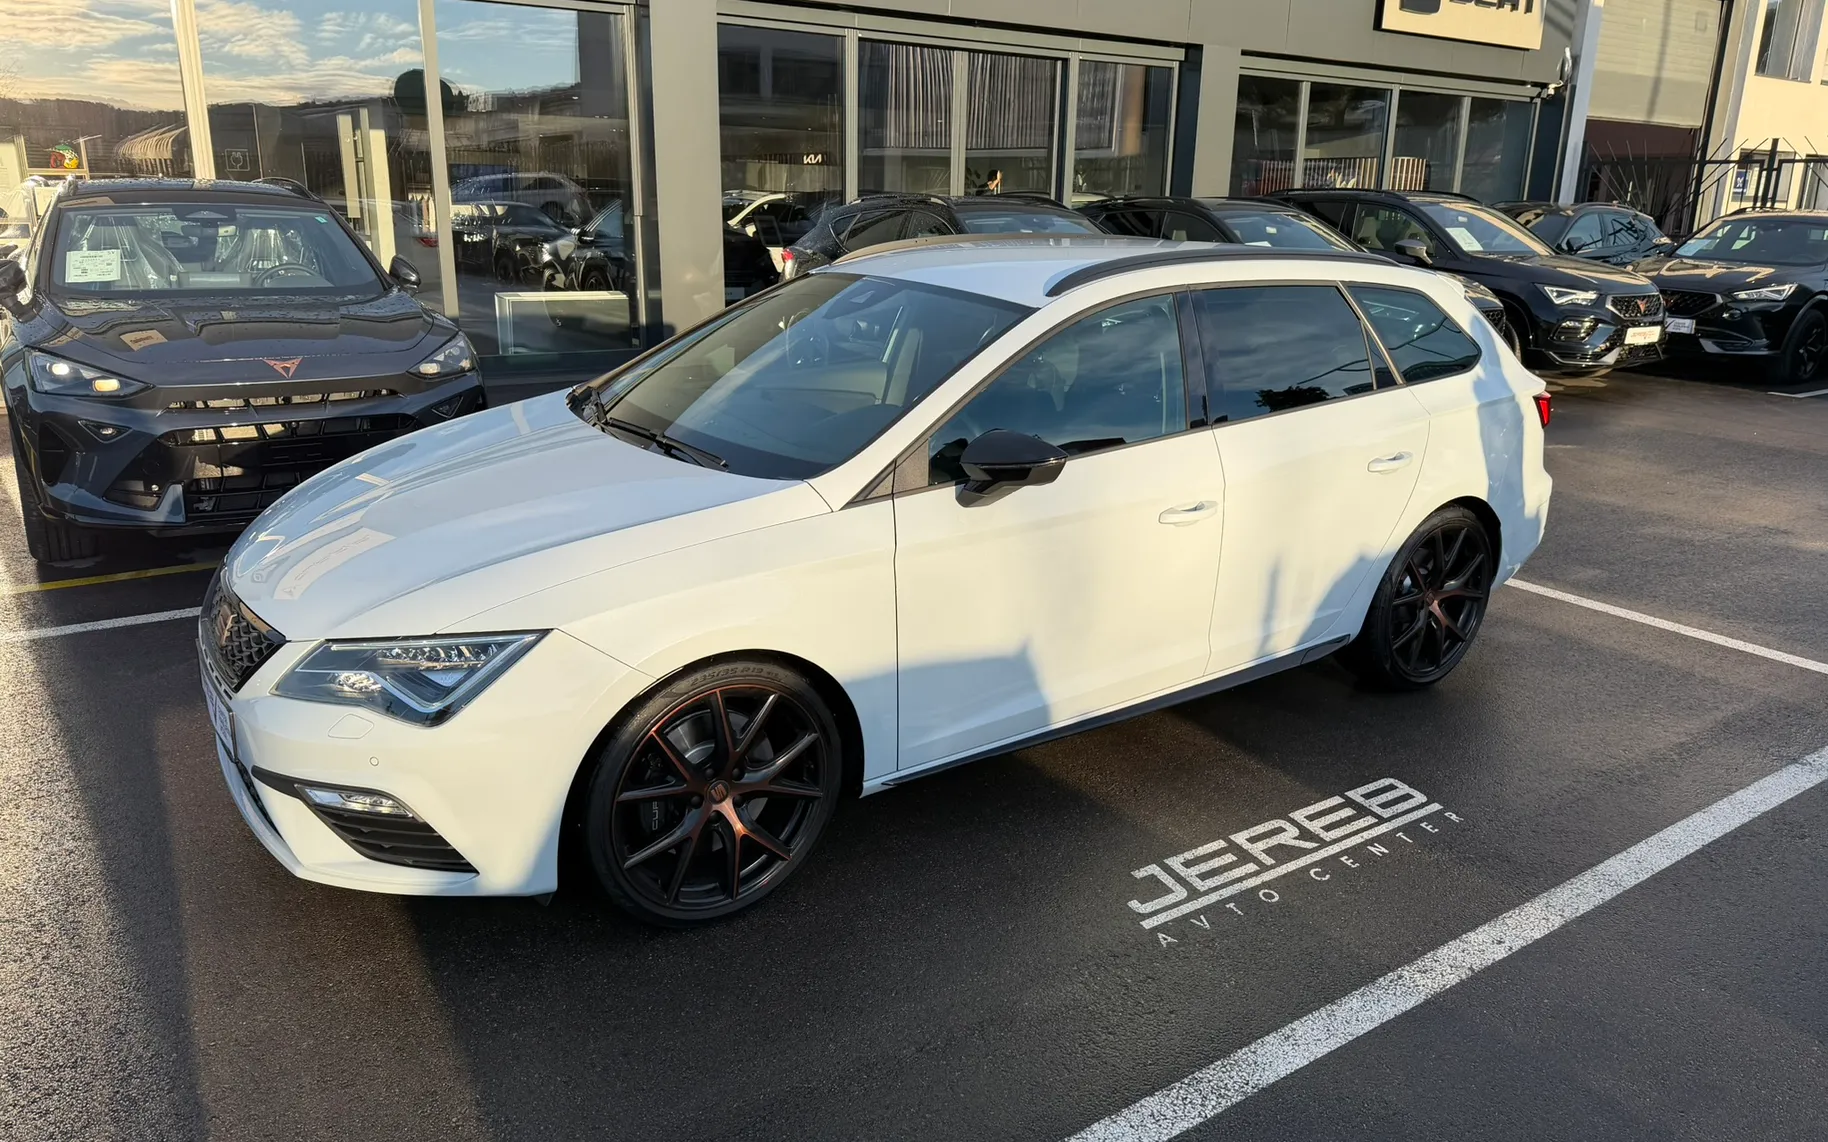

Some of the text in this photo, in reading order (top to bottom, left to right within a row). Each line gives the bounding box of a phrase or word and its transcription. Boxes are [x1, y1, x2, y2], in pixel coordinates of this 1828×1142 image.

[803, 153, 822, 164] KIA
[1126, 776, 1430, 914] JEREB
[1155, 810, 1465, 948] AVTO CENTER
